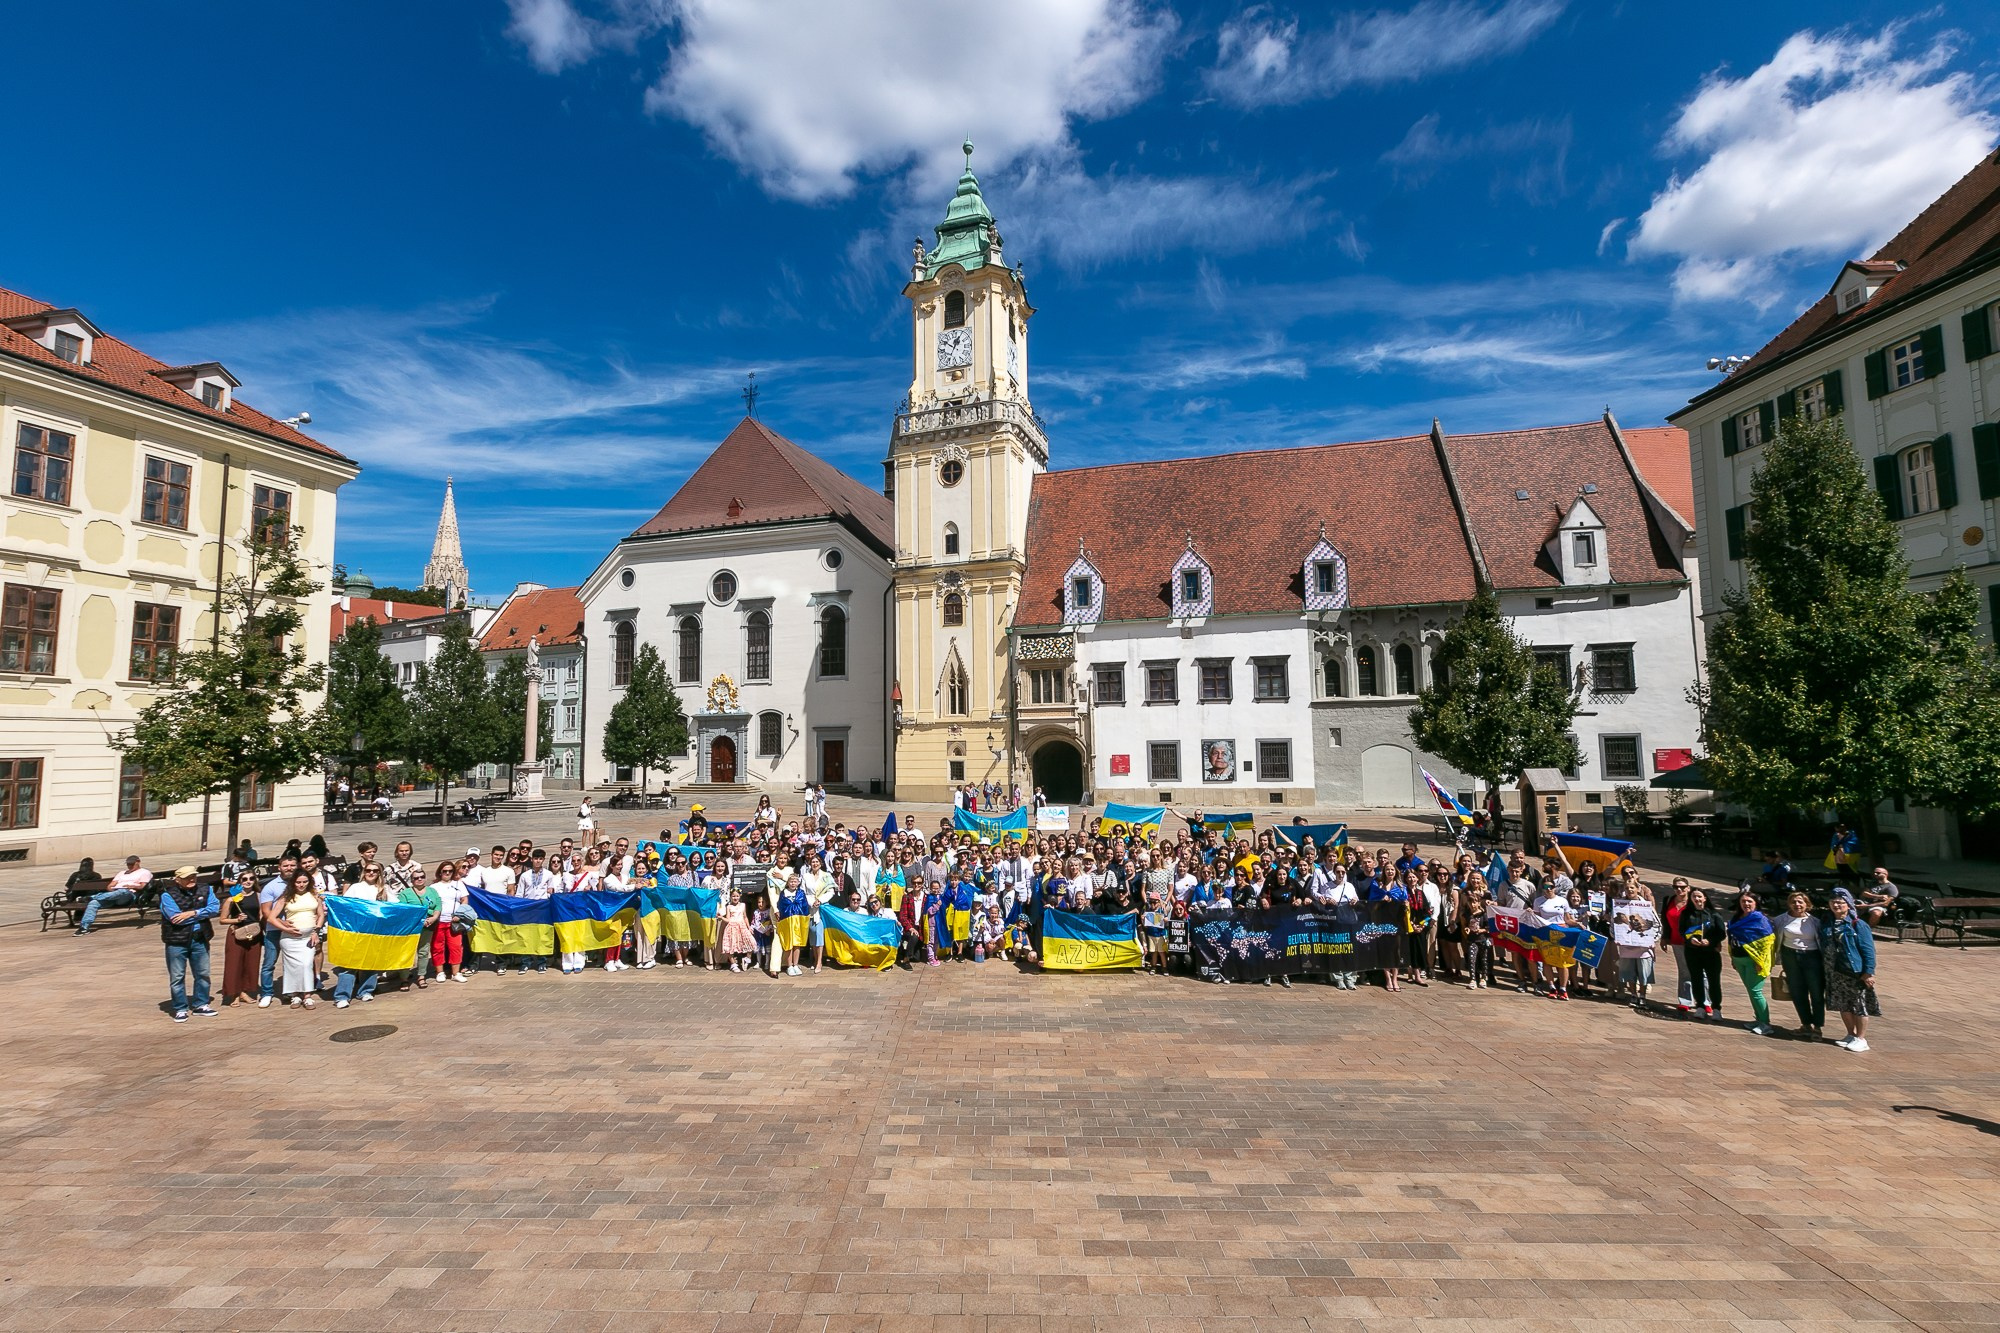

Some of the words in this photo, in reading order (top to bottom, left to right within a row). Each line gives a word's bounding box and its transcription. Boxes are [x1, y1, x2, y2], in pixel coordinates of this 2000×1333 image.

[1288, 933, 1310, 945] BELIEVE
[1312, 932, 1320, 942] IN
[1322, 932, 1350, 943] UKRAINE!
[1056, 944, 1116, 964] AZOV
[1286, 945, 1298, 956] ACT
[1300, 944, 1311, 954] FOR
[1313, 943, 1354, 954] DEMOCRACY!
